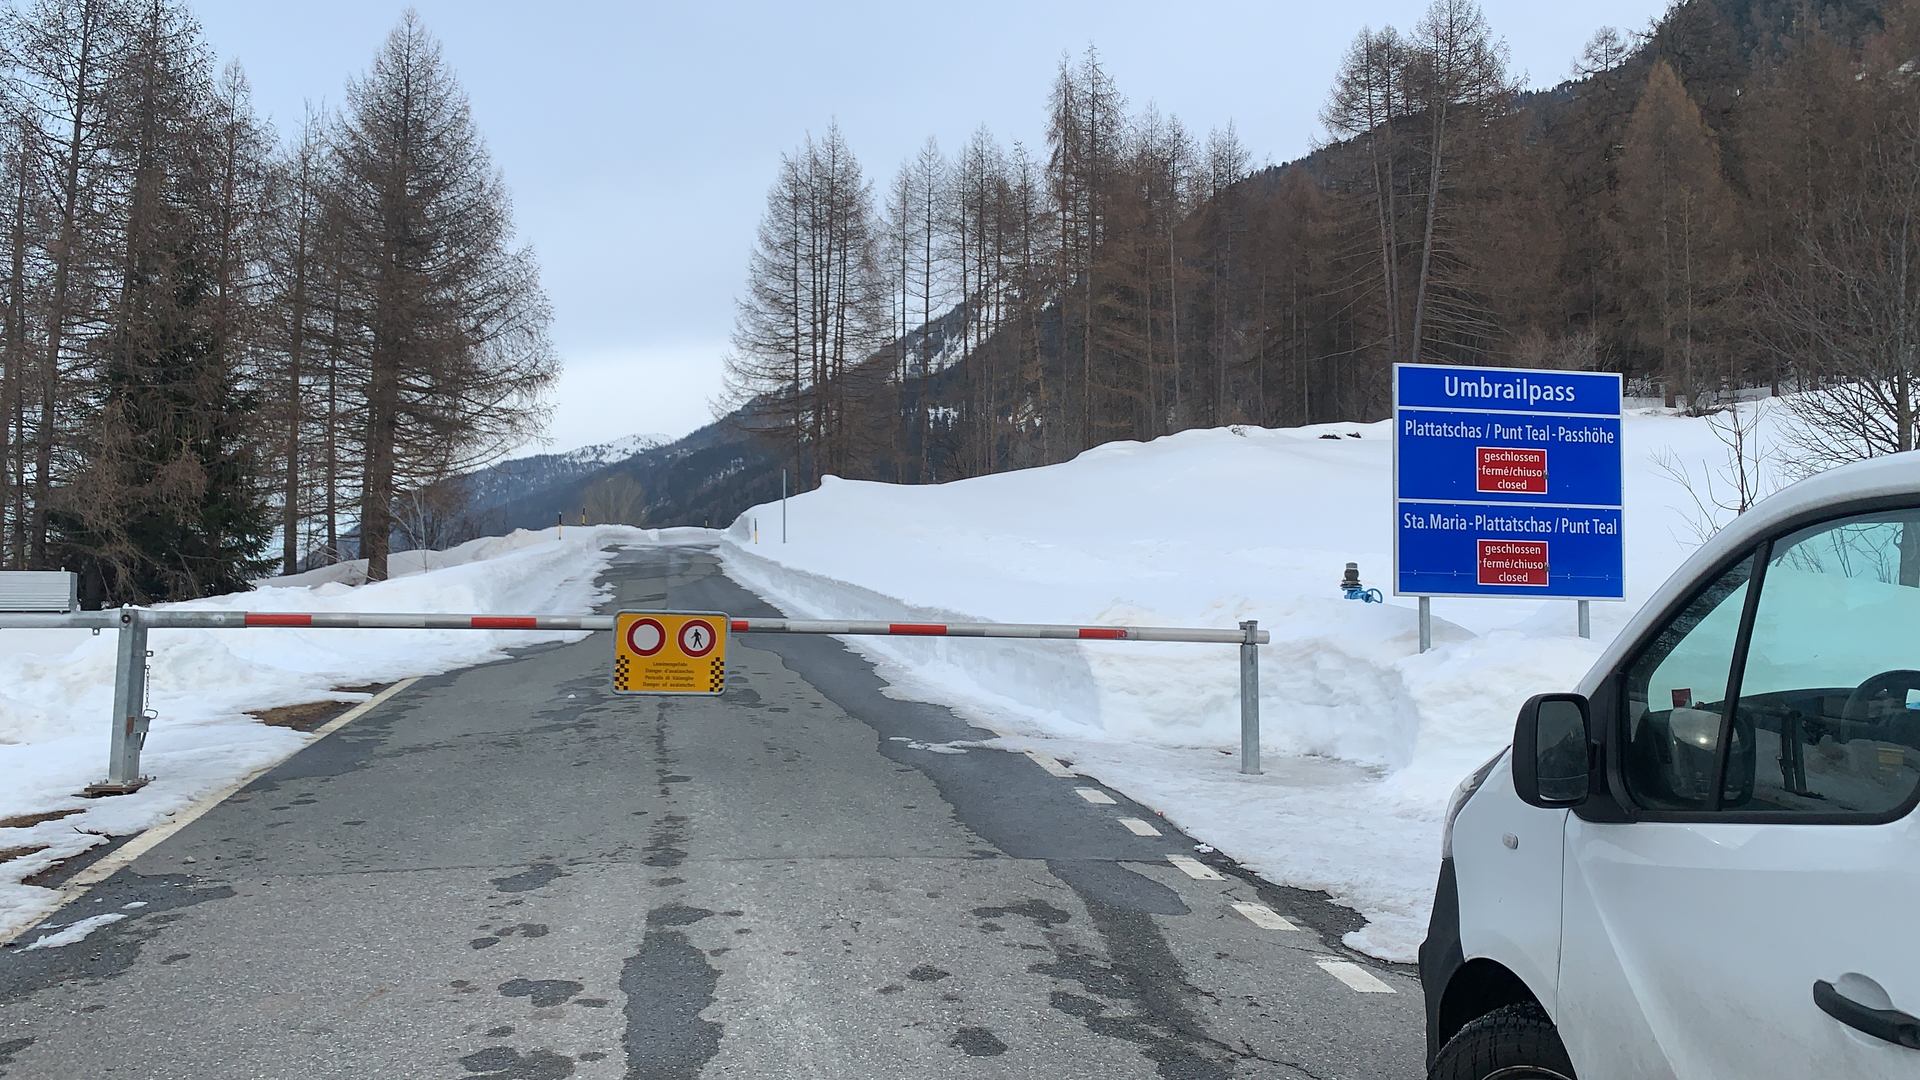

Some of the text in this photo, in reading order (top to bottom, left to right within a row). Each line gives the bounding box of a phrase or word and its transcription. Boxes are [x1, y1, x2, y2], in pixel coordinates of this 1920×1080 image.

[1444, 376, 1576, 405] Umbrailpass
[1405, 420, 1482, 439] Plattatschas
[1494, 424, 1523, 441] Punt
[1484, 451, 1540, 463] geschlossen
[1482, 465, 1542, 477] fermé/chiuso
[1497, 479, 1527, 490] closed
[1561, 517, 1590, 534] Punt
[1592, 518, 1617, 535] Teal
[1485, 544, 1541, 556] geschlossen
[1483, 558, 1543, 569] fermé/chiuso
[1499, 571, 1528, 582] closed
